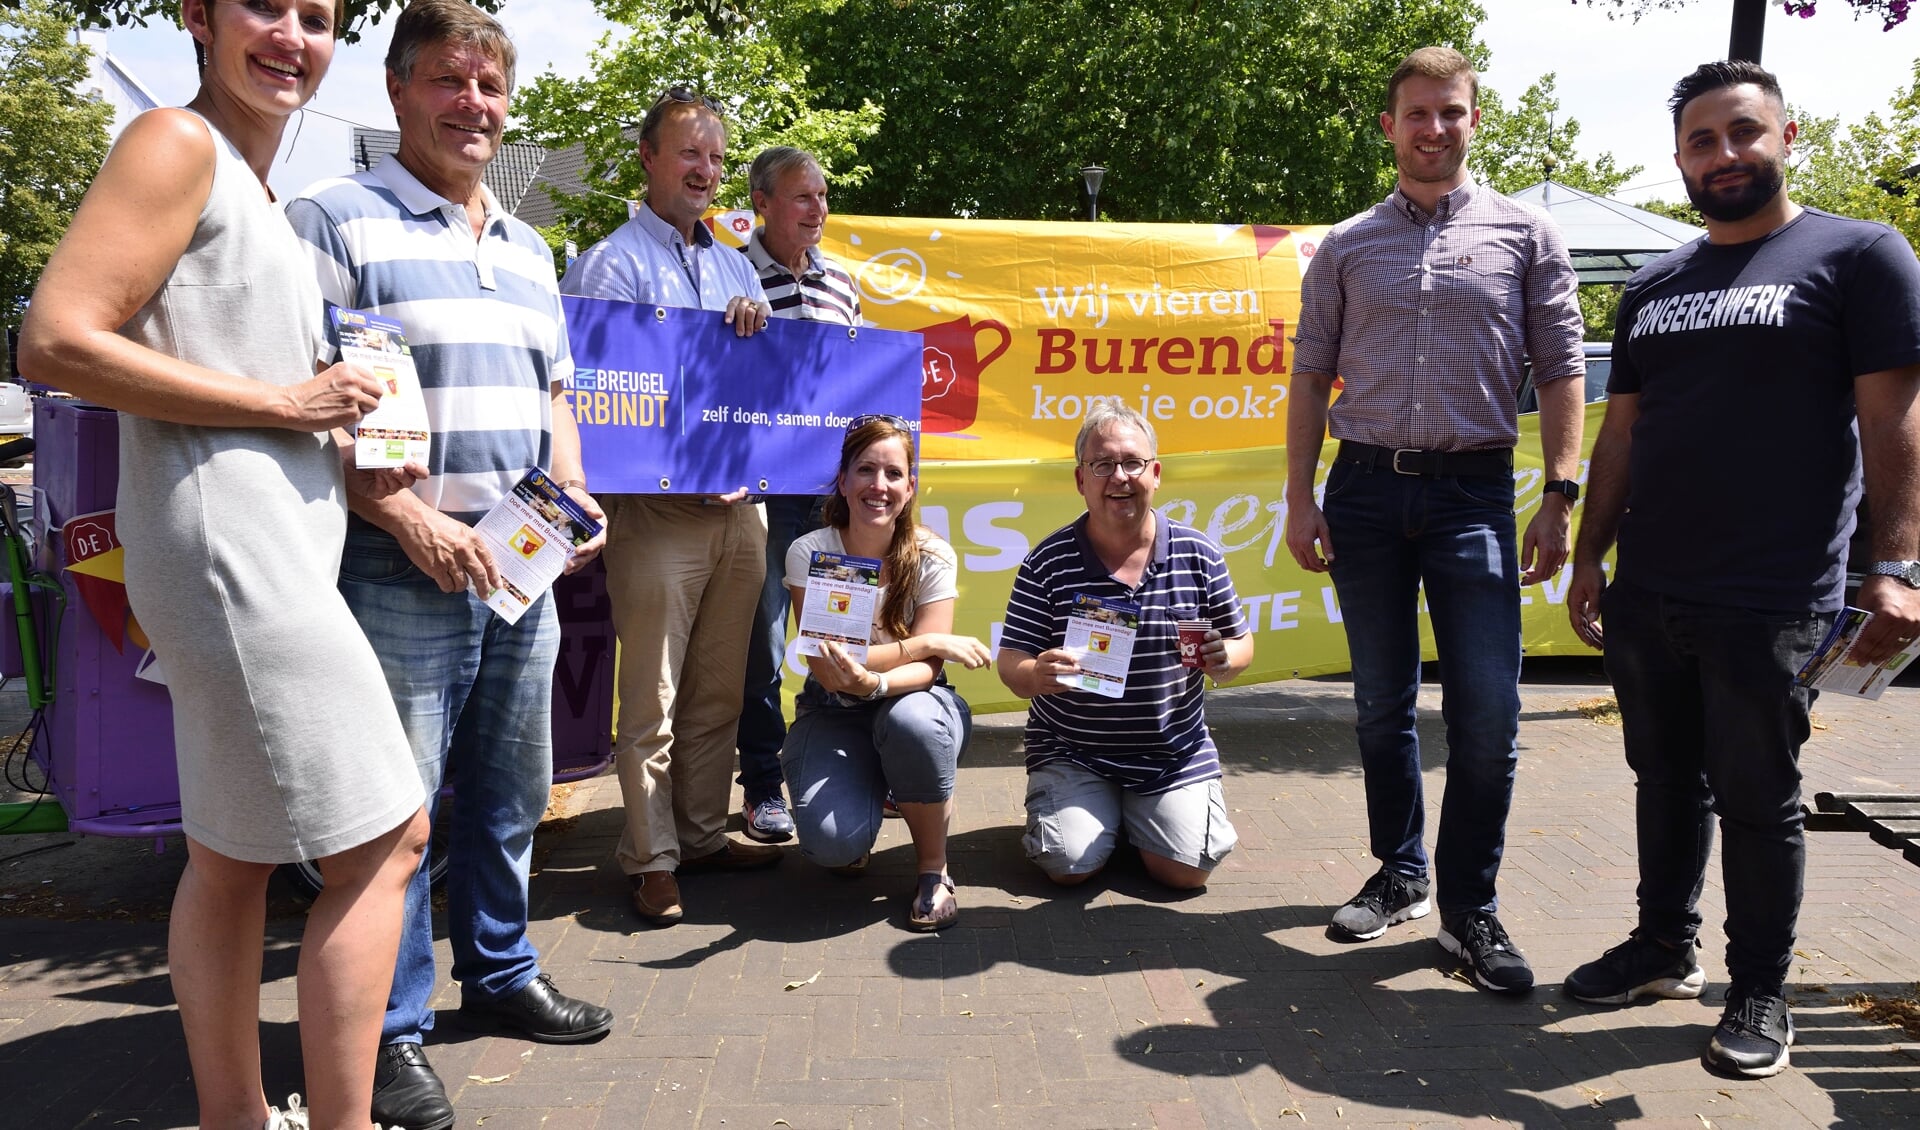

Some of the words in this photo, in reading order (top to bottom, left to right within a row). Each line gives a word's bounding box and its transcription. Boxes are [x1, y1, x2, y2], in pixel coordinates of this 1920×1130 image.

[1035, 283, 1110, 328] Wij
[1124, 283, 1260, 317] vieren
[1035, 319, 1288, 375] Burend
[597, 369, 669, 395] BREUGEL
[1140, 384, 1177, 420] je
[1189, 385, 1288, 420] ook?
[702, 406, 729, 422] zelf
[733, 407, 772, 427] doen,
[776, 413, 821, 427] samen
[509, 497, 521, 509] Doe
[520, 507, 534, 520] mee
[533, 518, 545, 530] met
[544, 527, 574, 554] Burendag!
